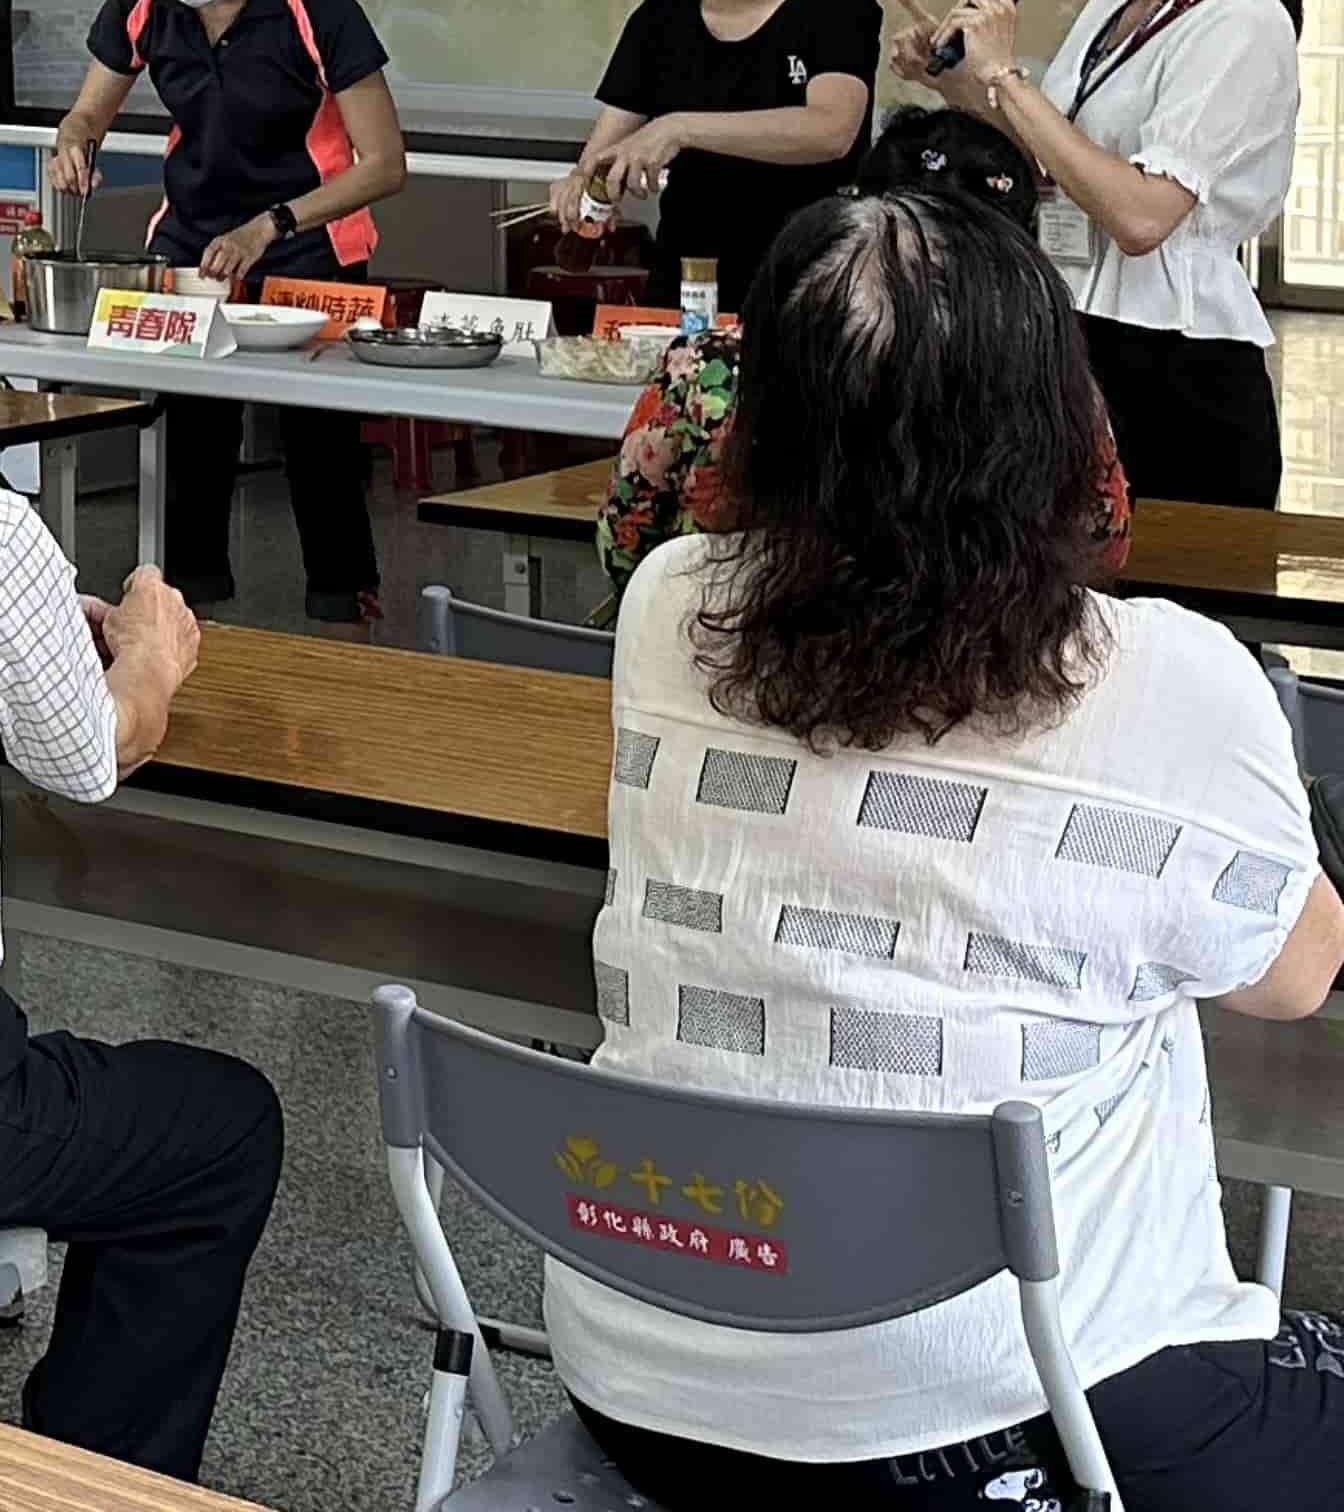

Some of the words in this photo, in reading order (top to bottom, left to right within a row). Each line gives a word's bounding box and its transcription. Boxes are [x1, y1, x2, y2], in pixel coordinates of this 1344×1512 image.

[786, 55, 808, 85] LA
[628, 1158, 786, 1228] 十七份
[576, 1201, 710, 1254] 彰化縣政府
[727, 1237, 780, 1267] 廣告
